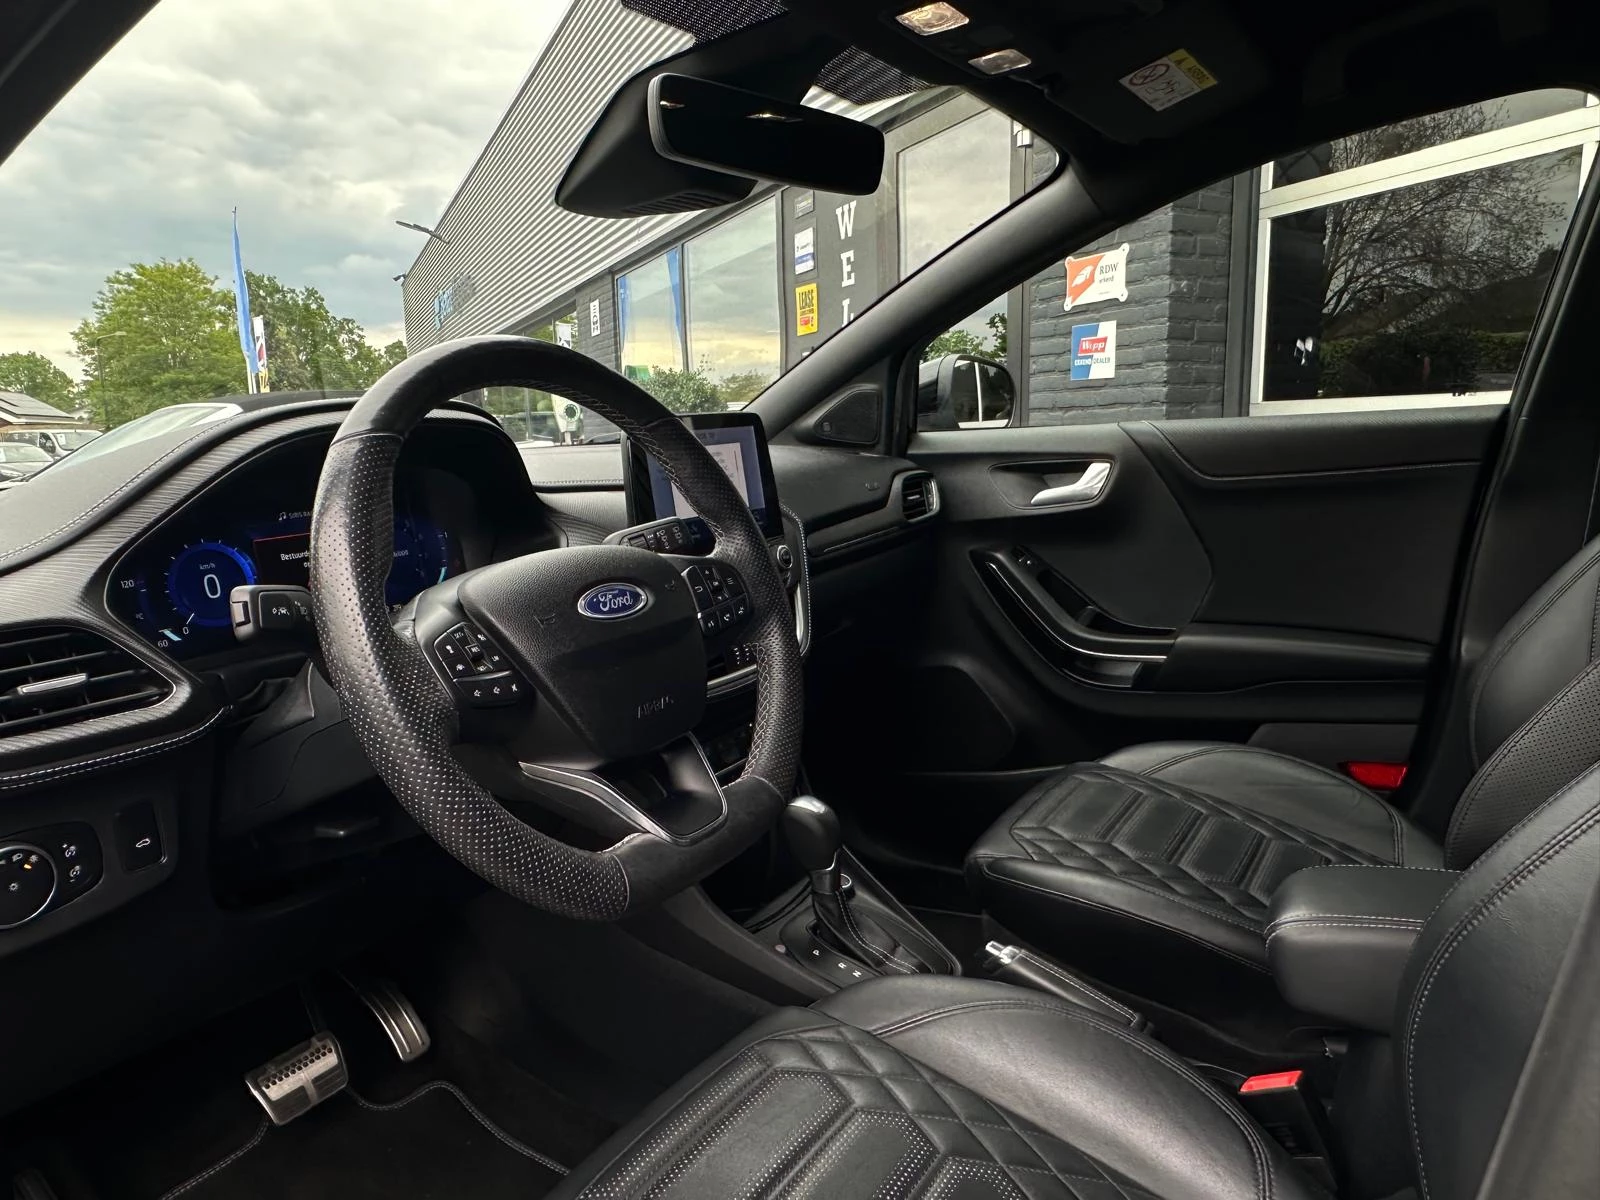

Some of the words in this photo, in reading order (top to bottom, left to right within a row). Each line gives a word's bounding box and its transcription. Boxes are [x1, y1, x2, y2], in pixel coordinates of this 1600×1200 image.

[1099, 262, 1119, 275] RDW
[799, 289, 814, 310] LEASE
[199, 562, 216, 570] km/h
[121, 579, 135, 589] 120
[203, 574, 221, 599] 0
[598, 590, 633, 611] Ford
[182, 626, 190, 635] 0
[157, 639, 169, 648] 60
